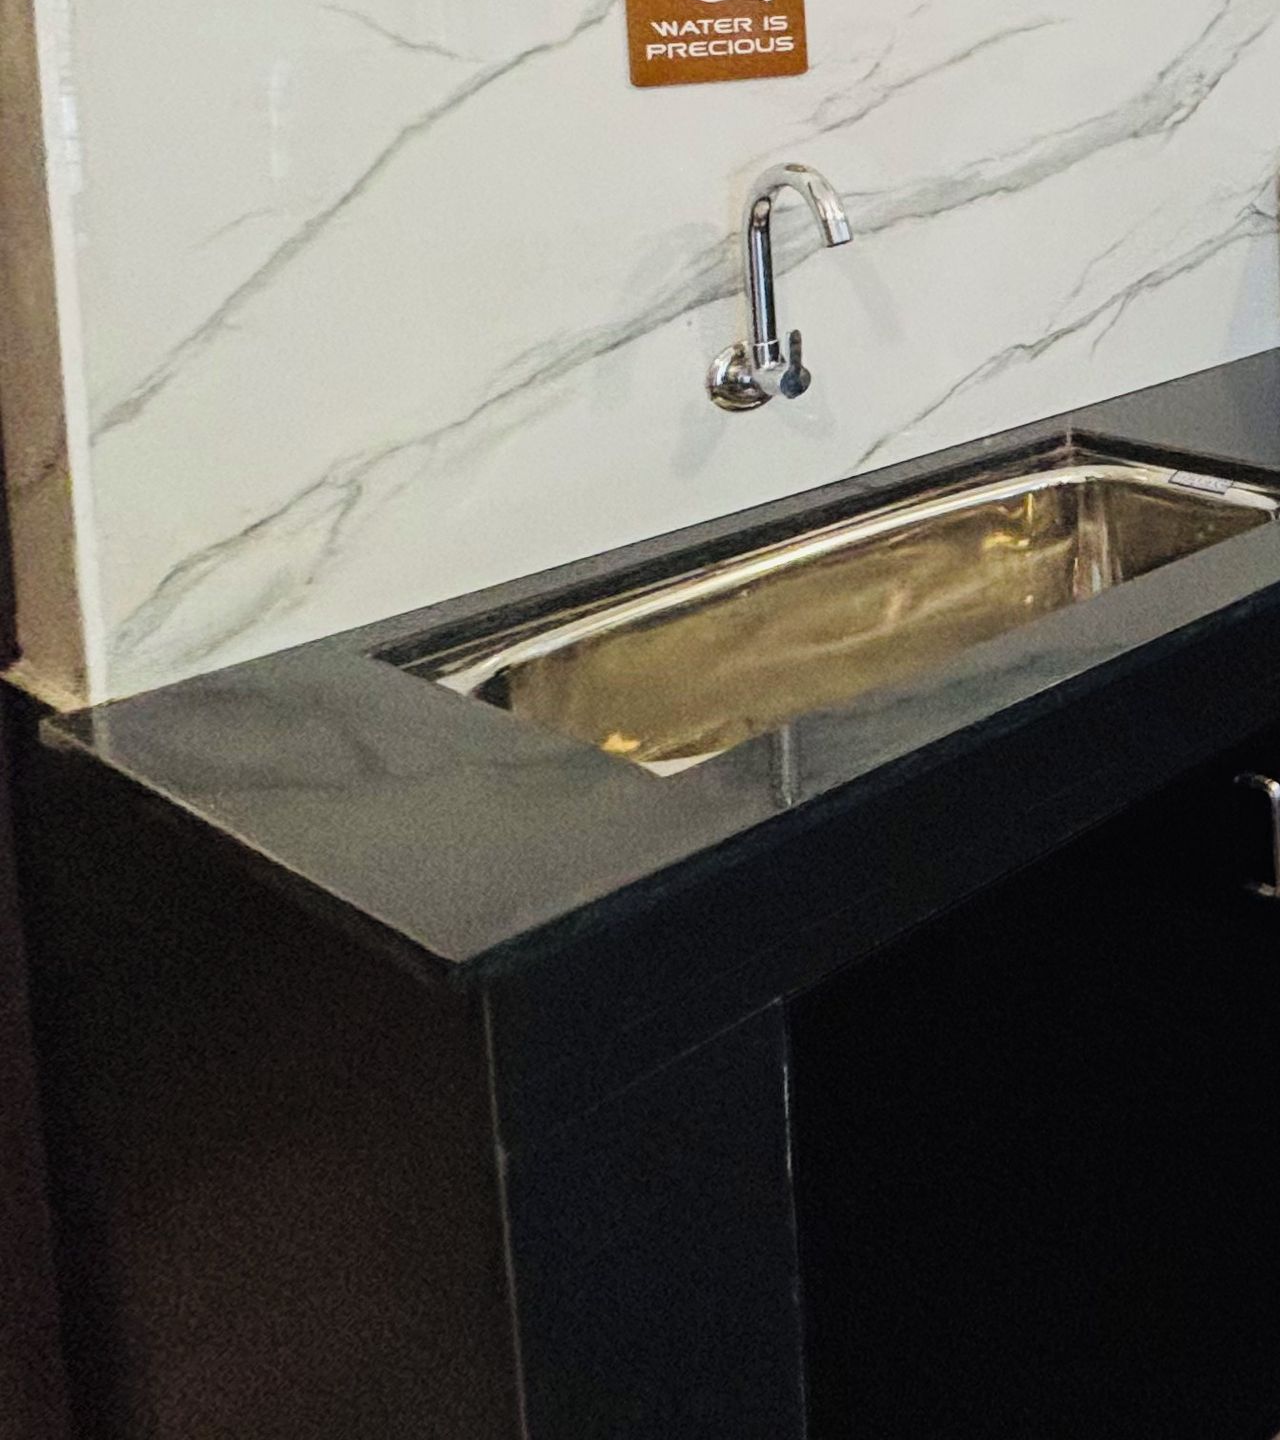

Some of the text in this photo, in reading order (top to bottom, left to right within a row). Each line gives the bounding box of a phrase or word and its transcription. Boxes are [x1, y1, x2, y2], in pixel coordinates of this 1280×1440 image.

[651, 15, 789, 37] WATER IS
[646, 36, 794, 60] PRECIOUS
